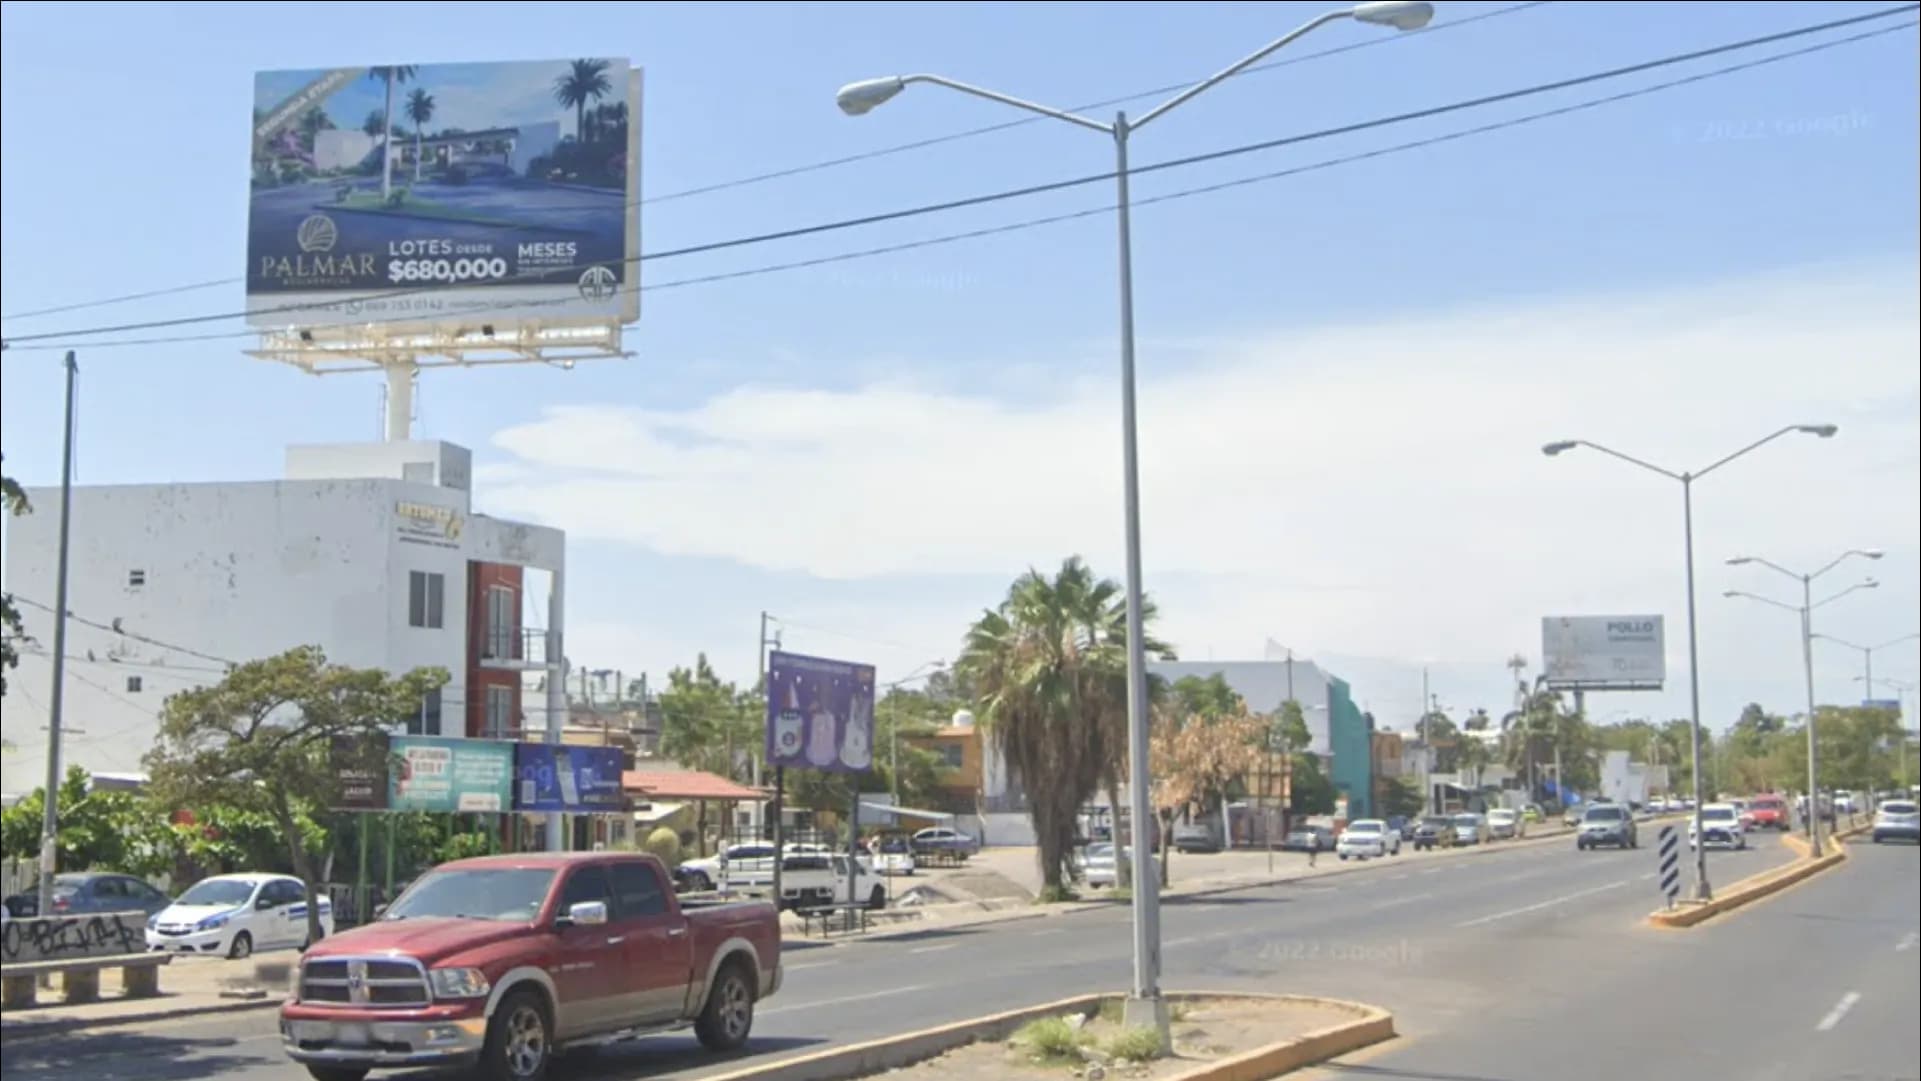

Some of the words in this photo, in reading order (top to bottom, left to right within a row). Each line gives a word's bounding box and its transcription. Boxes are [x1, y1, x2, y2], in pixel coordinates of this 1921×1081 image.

[388, 239, 453, 256] LOTES
[455, 244, 493, 254] DESDE
[518, 241, 577, 257] MESES
[261, 253, 377, 278] PALMAR
[388, 258, 507, 283] $680,000
[1607, 621, 1655, 633] POLLO
